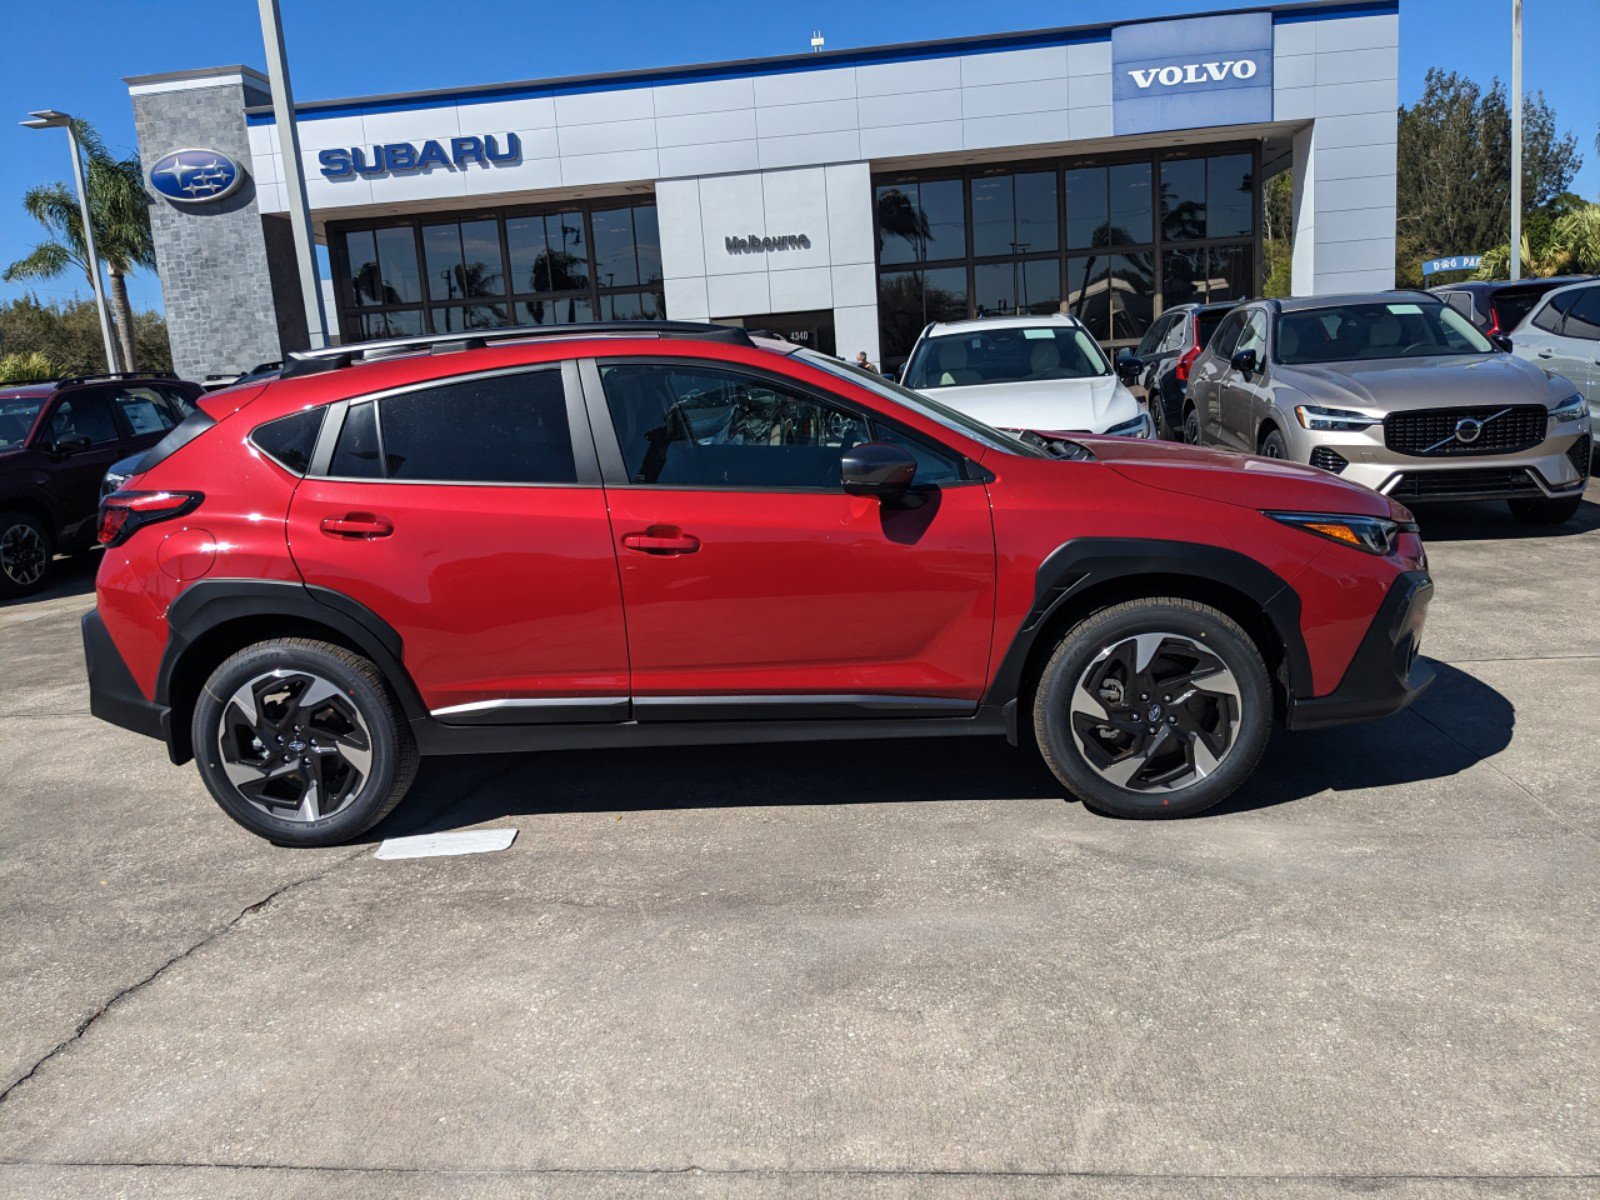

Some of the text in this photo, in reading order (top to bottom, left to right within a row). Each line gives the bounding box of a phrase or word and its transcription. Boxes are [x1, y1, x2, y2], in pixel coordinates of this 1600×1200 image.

[1127, 59, 1257, 89] VOLVO
[318, 132, 521, 178] SUBARU
[724, 233, 810, 253] Melbourne
[790, 330, 809, 341] 4340
